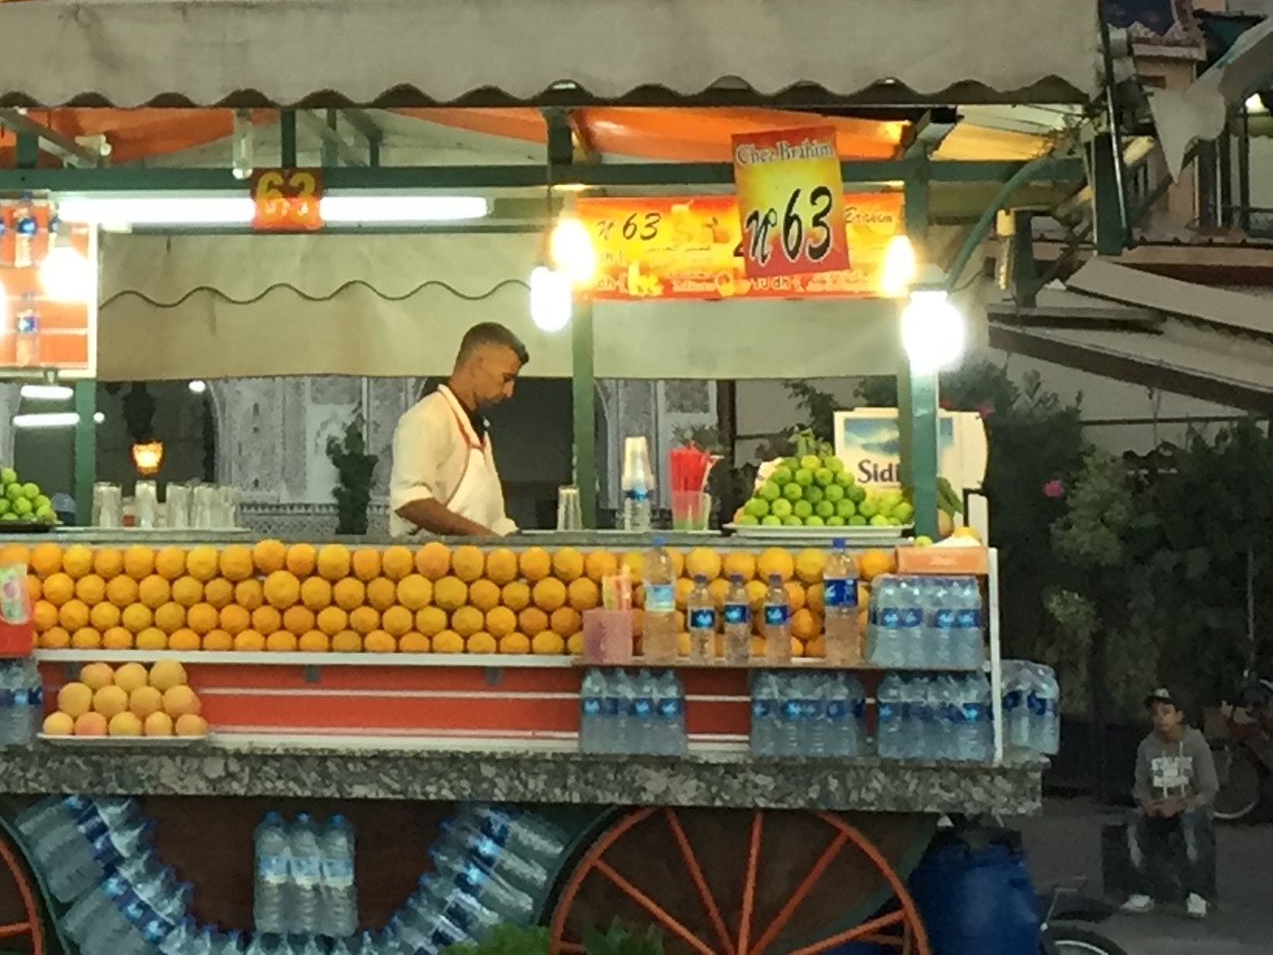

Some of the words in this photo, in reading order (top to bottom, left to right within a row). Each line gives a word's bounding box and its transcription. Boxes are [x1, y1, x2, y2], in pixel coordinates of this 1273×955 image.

[737, 145, 775, 165] Chez
[778, 140, 834, 161] Brahim
[256, 172, 317, 224] 63
